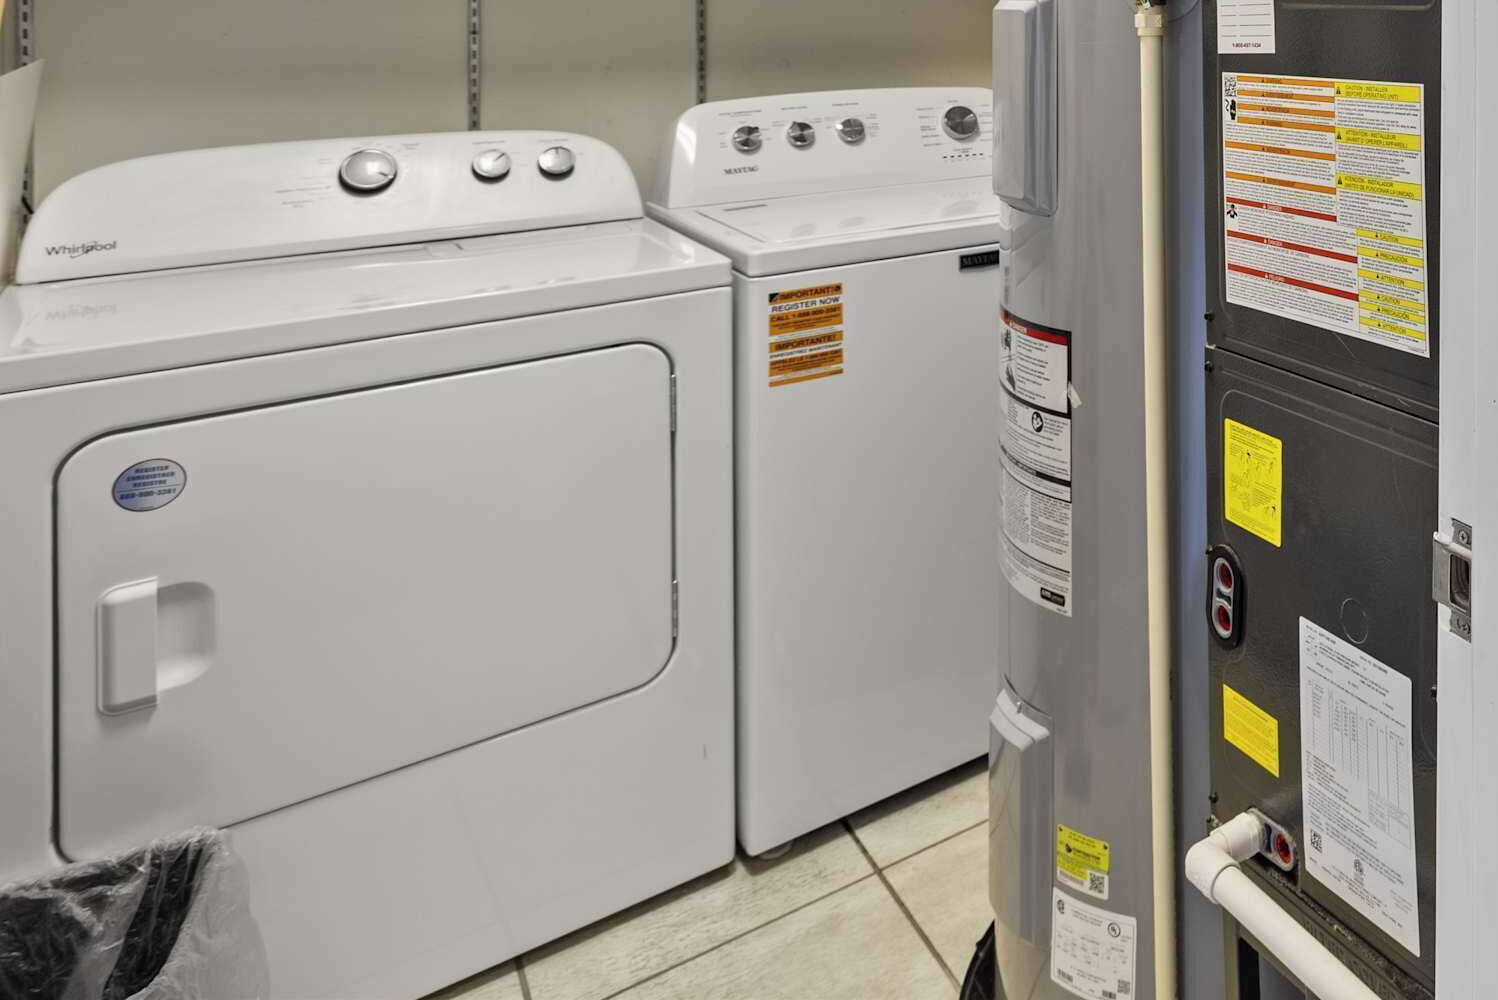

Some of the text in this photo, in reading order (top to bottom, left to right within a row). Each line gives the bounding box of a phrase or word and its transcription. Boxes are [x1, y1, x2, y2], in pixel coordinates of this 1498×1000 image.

[724, 166, 759, 176] MAYTAG
[44, 240, 117, 258] Whirlpool
[771, 296, 841, 313] REGISTER NOW
[135, 465, 169, 473] REGISTER
